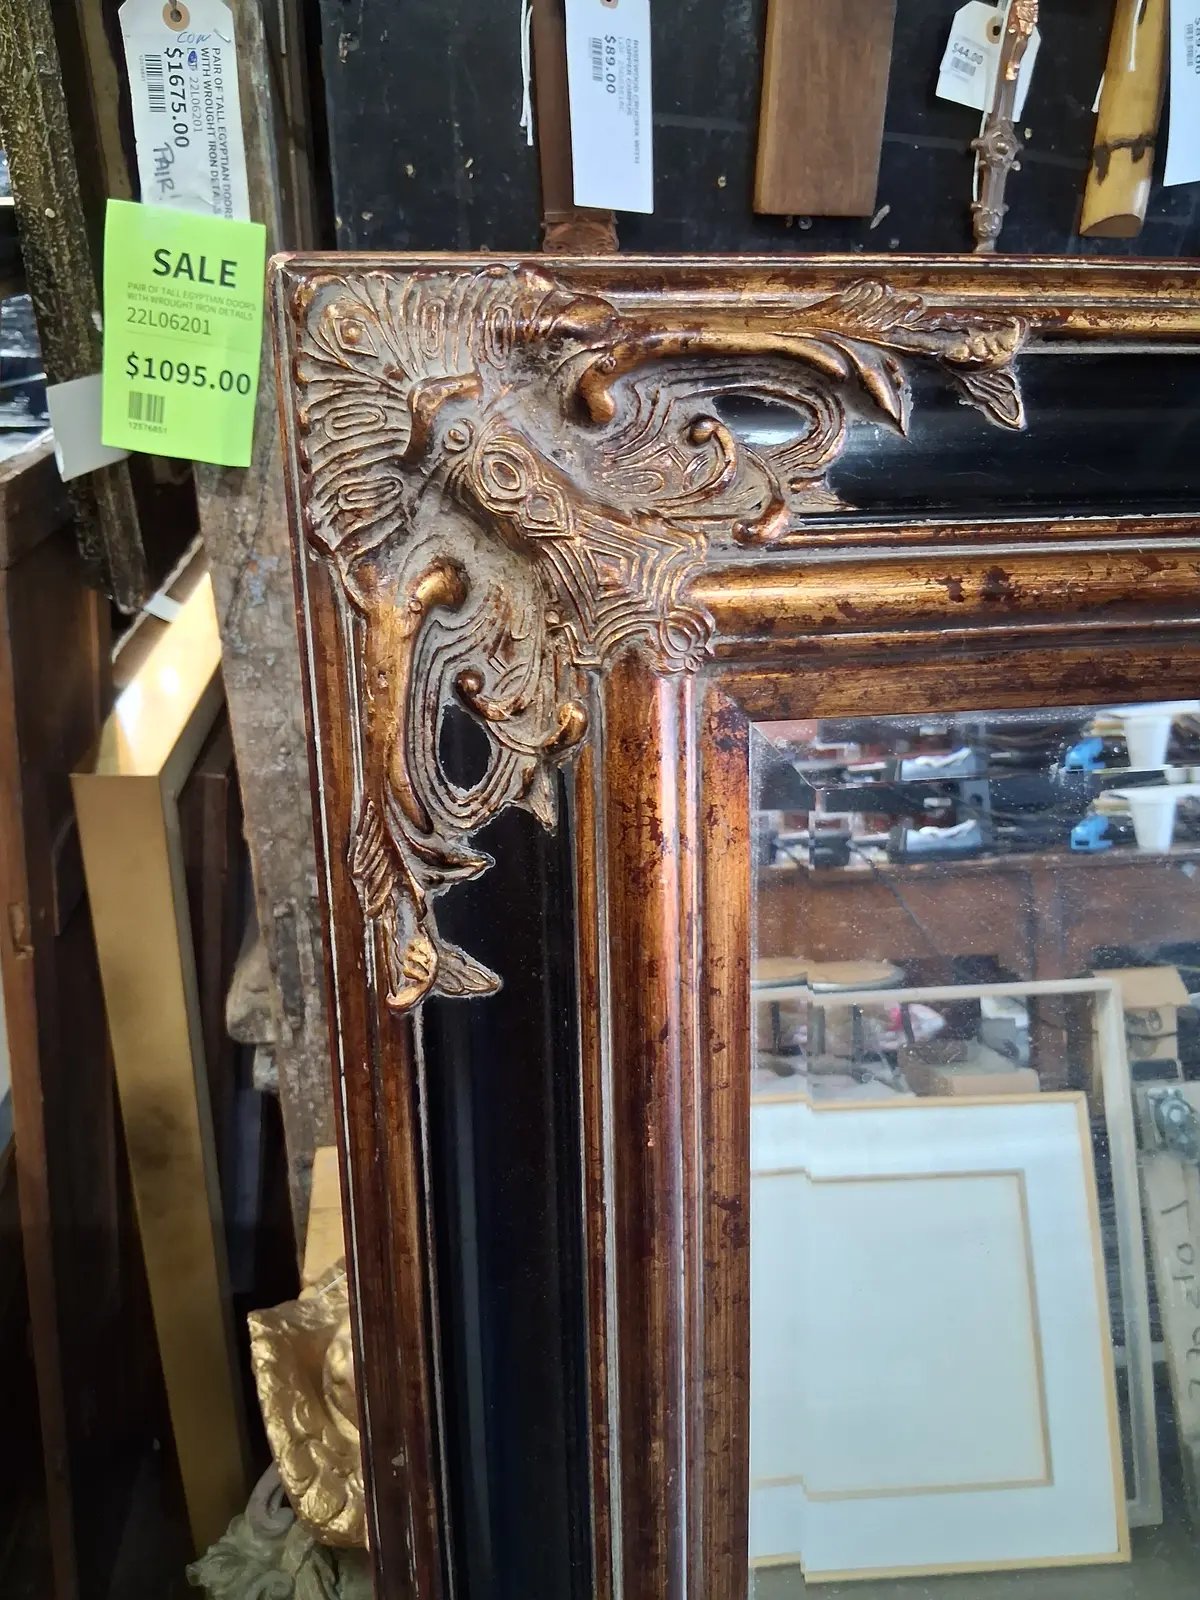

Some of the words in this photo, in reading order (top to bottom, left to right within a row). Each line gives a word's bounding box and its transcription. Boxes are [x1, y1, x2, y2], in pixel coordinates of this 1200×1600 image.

[201, 48, 211, 77] WITH
[212, 48, 221, 74] PAIR
[604, 34, 616, 94] $89.00
[165, 47, 189, 147] $1675.00
[215, 78, 223, 91] OF
[190, 77, 200, 132] 22L06201
[203, 81, 215, 137] WROUGHT
[216, 95, 225, 122] TALL
[208, 141, 216, 167] IRON
[219, 127, 229, 181] EGYPTIAN
[153, 143, 181, 200] PAIR!
[224, 185, 232, 219] DOORS
[152, 248, 238, 289] SALE
[127, 282, 145, 292] PAIR
[148, 284, 159, 293] OF
[162, 286, 181, 298] TALL
[183, 290, 224, 305] EGYPTIAN
[226, 298, 257, 311] DOORS
[127, 293, 149, 303] WITH
[151, 295, 194, 310] WROUGHT
[196, 302, 216, 314] IRON
[218, 306, 253, 321] DETAILS
[127, 307, 212, 336] 22L06201
[126, 351, 251, 395] $1095.00
